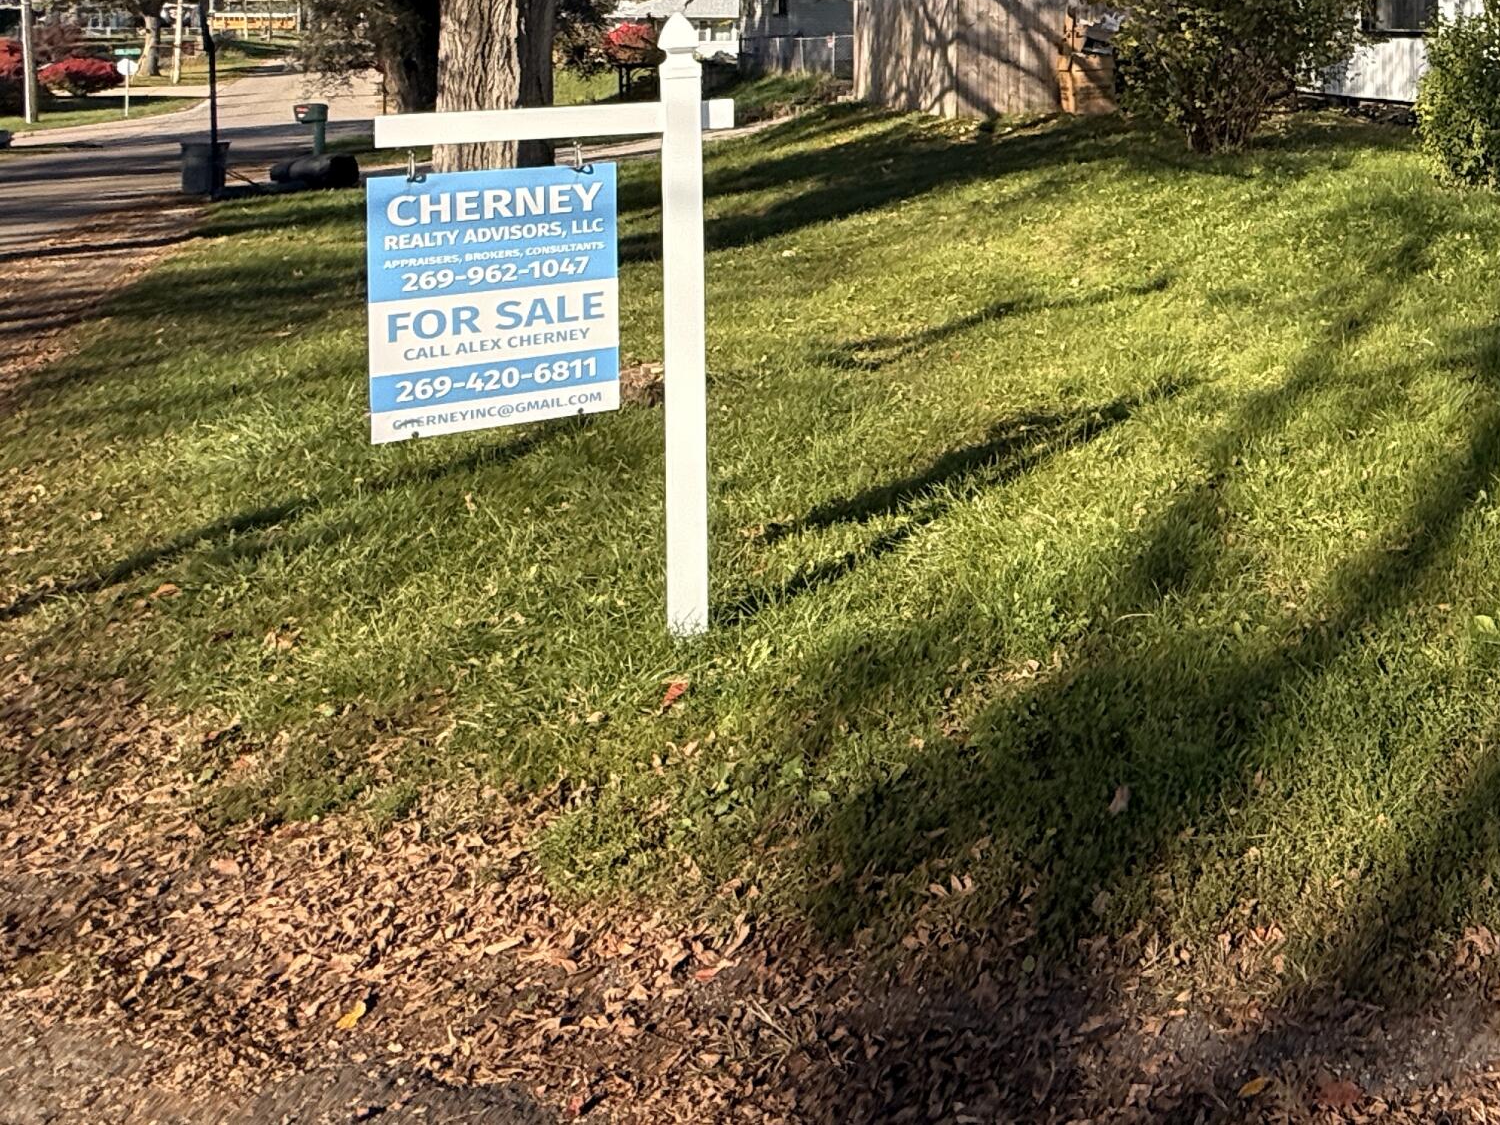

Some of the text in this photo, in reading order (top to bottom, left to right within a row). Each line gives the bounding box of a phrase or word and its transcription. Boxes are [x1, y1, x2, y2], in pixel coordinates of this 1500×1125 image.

[386, 182, 603, 227] CHERNEY
[384, 217, 604, 250] REALTY ADVISORS, LLC
[383, 241, 605, 270] APPRAISERS, BROKERS, CONSULTANTS
[401, 256, 590, 292] 269-962-1047
[387, 291, 605, 343] FOR SALE
[403, 327, 591, 361] CALL ALEX CHERNEY
[395, 357, 597, 403] 269-420-6811
